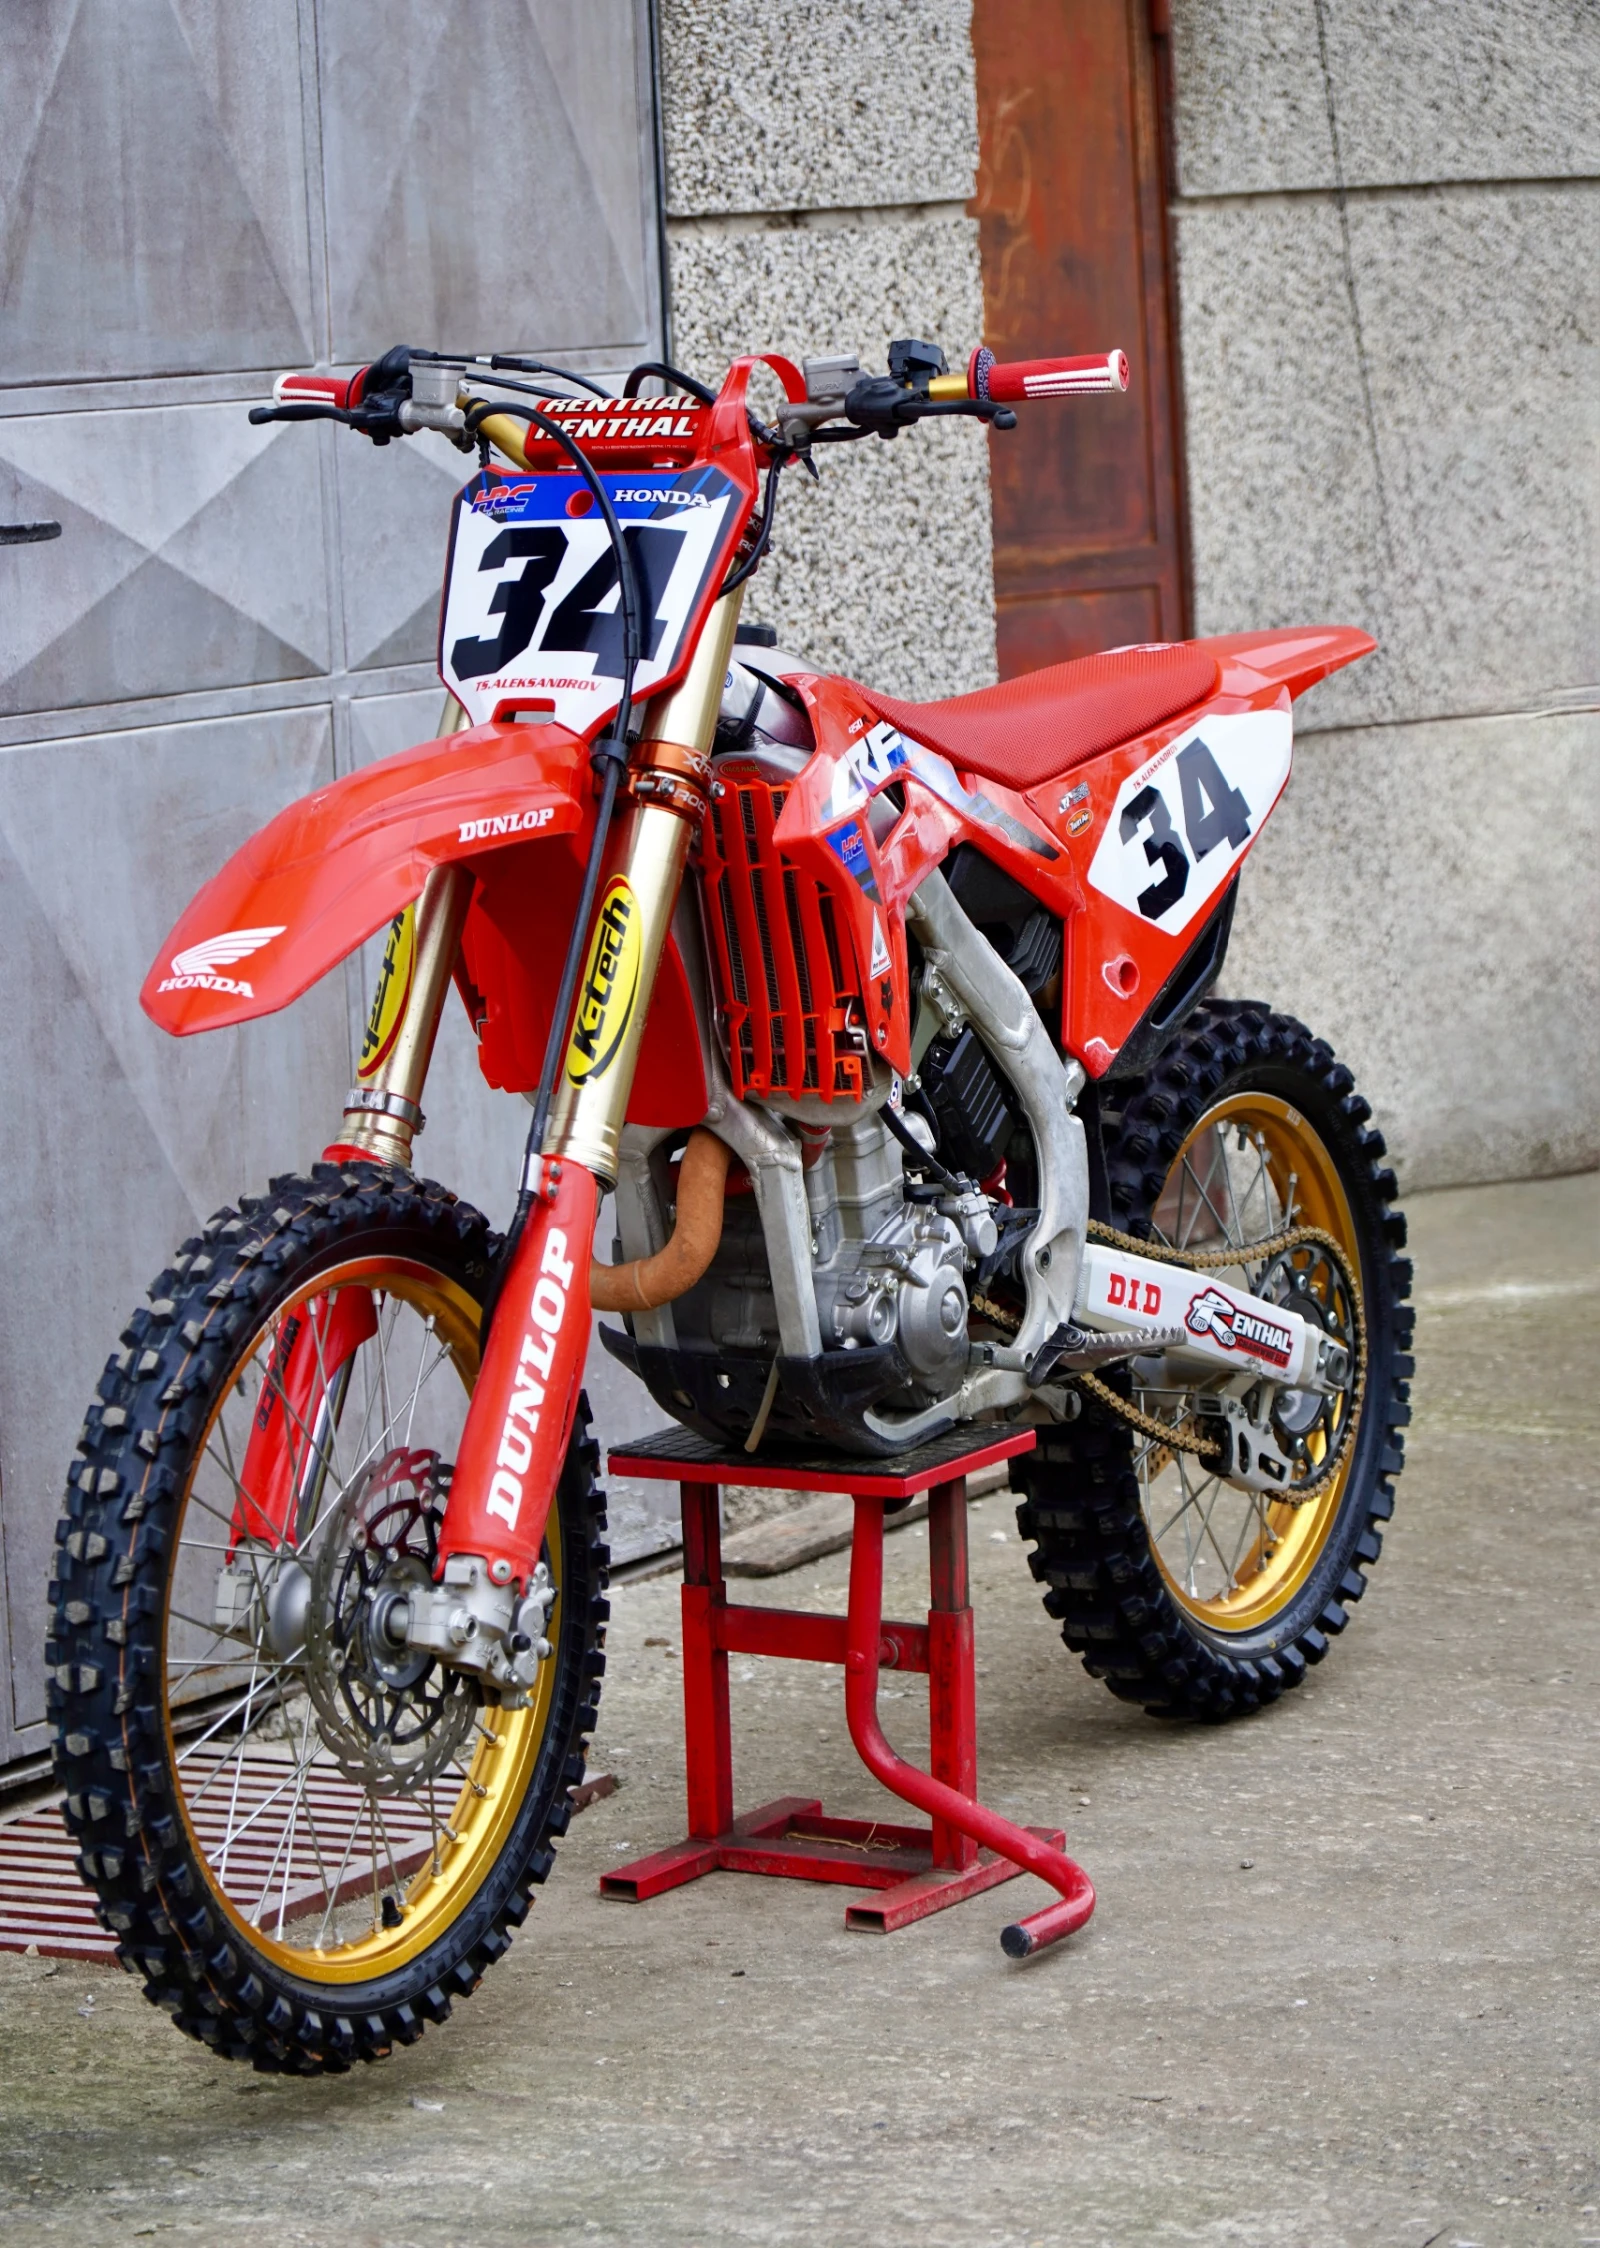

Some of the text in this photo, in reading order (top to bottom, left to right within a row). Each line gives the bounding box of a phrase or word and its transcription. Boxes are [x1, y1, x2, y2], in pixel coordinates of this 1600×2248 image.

[543, 395, 701, 413] RENTHAL
[470, 483, 537, 514] HRC
[613, 489, 711, 508] HONDA
[451, 526, 688, 682] 34
[458, 807, 555, 843] DUNLOP
[1119, 736, 1252, 921] 34
[156, 974, 255, 999] HONDA
[573, 896, 632, 1063] K-tech
[1107, 1272, 1163, 1317] D.I.D
[486, 1227, 575, 1532] DUNLOP
